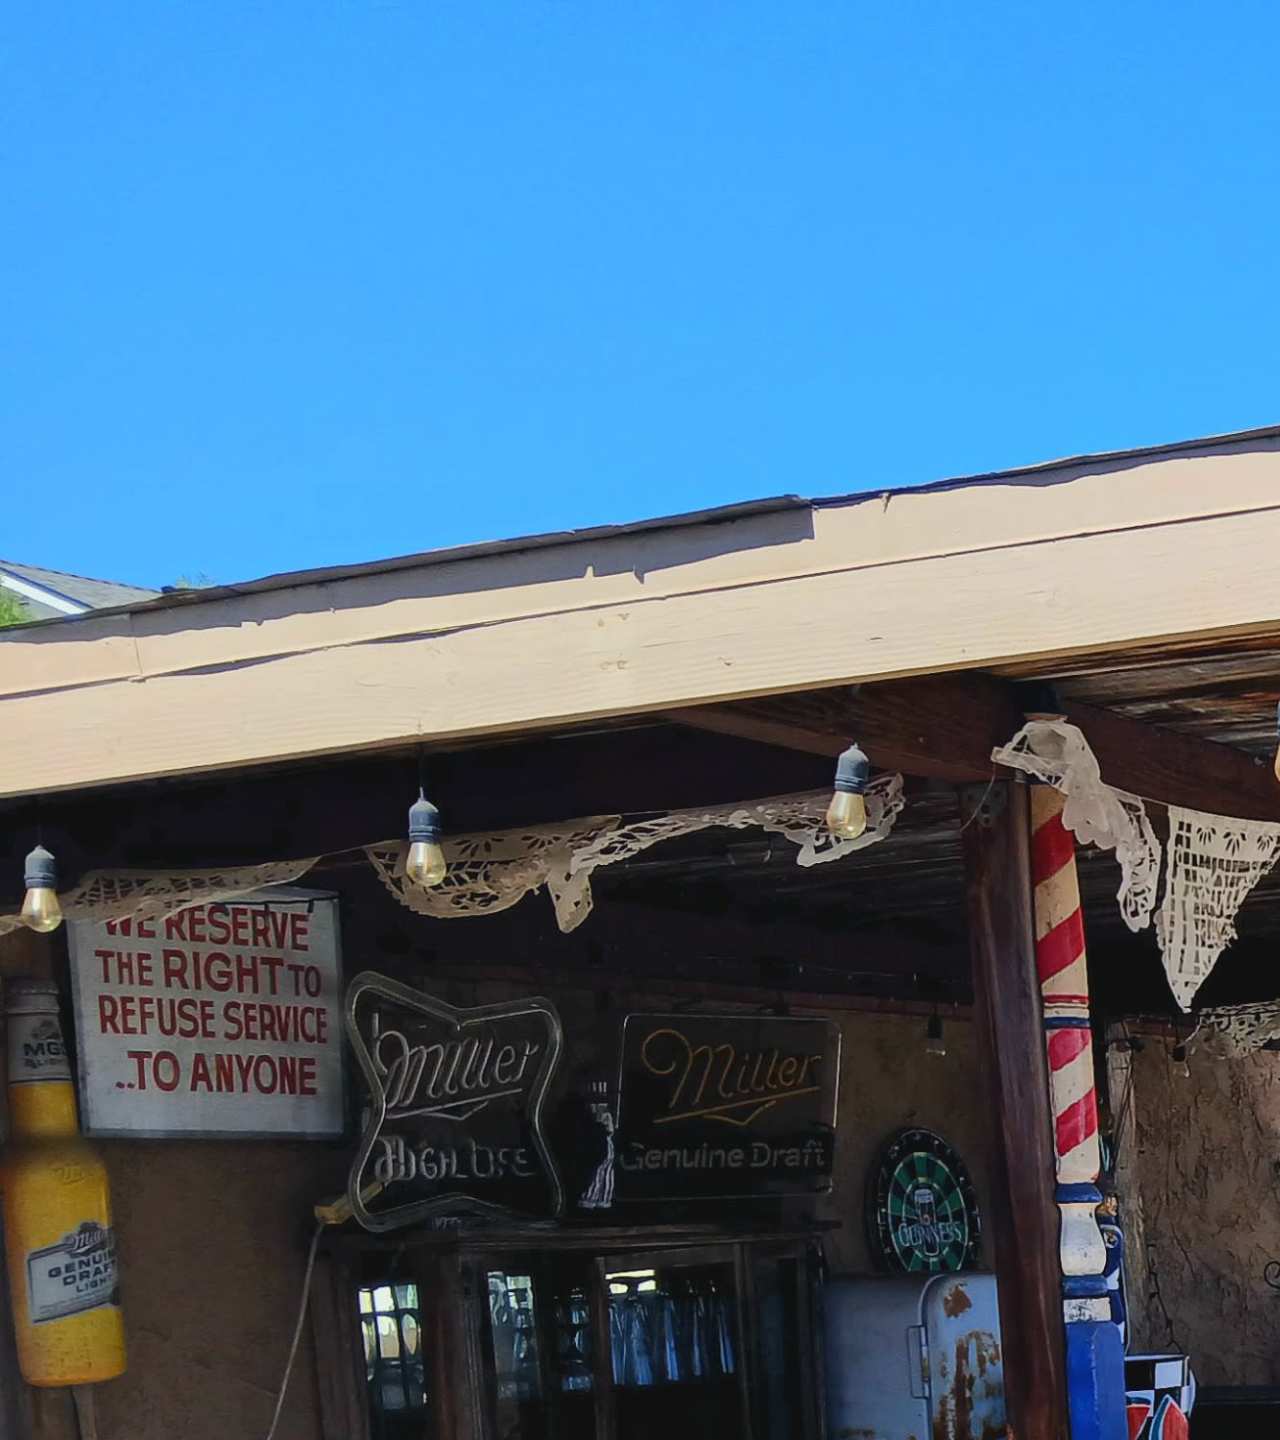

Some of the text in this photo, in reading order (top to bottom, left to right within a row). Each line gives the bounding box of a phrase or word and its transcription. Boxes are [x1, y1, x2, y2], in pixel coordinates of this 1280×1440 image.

[164, 903, 310, 952] RESERVE
[95, 948, 322, 998] THE RIGHT TO
[99, 995, 328, 1045] REFUSE SERVICE
[190, 1052, 318, 1096] ANYONE
[641, 1028, 823, 1110] Miller
[621, 1137, 826, 1171] Genuine Draft
